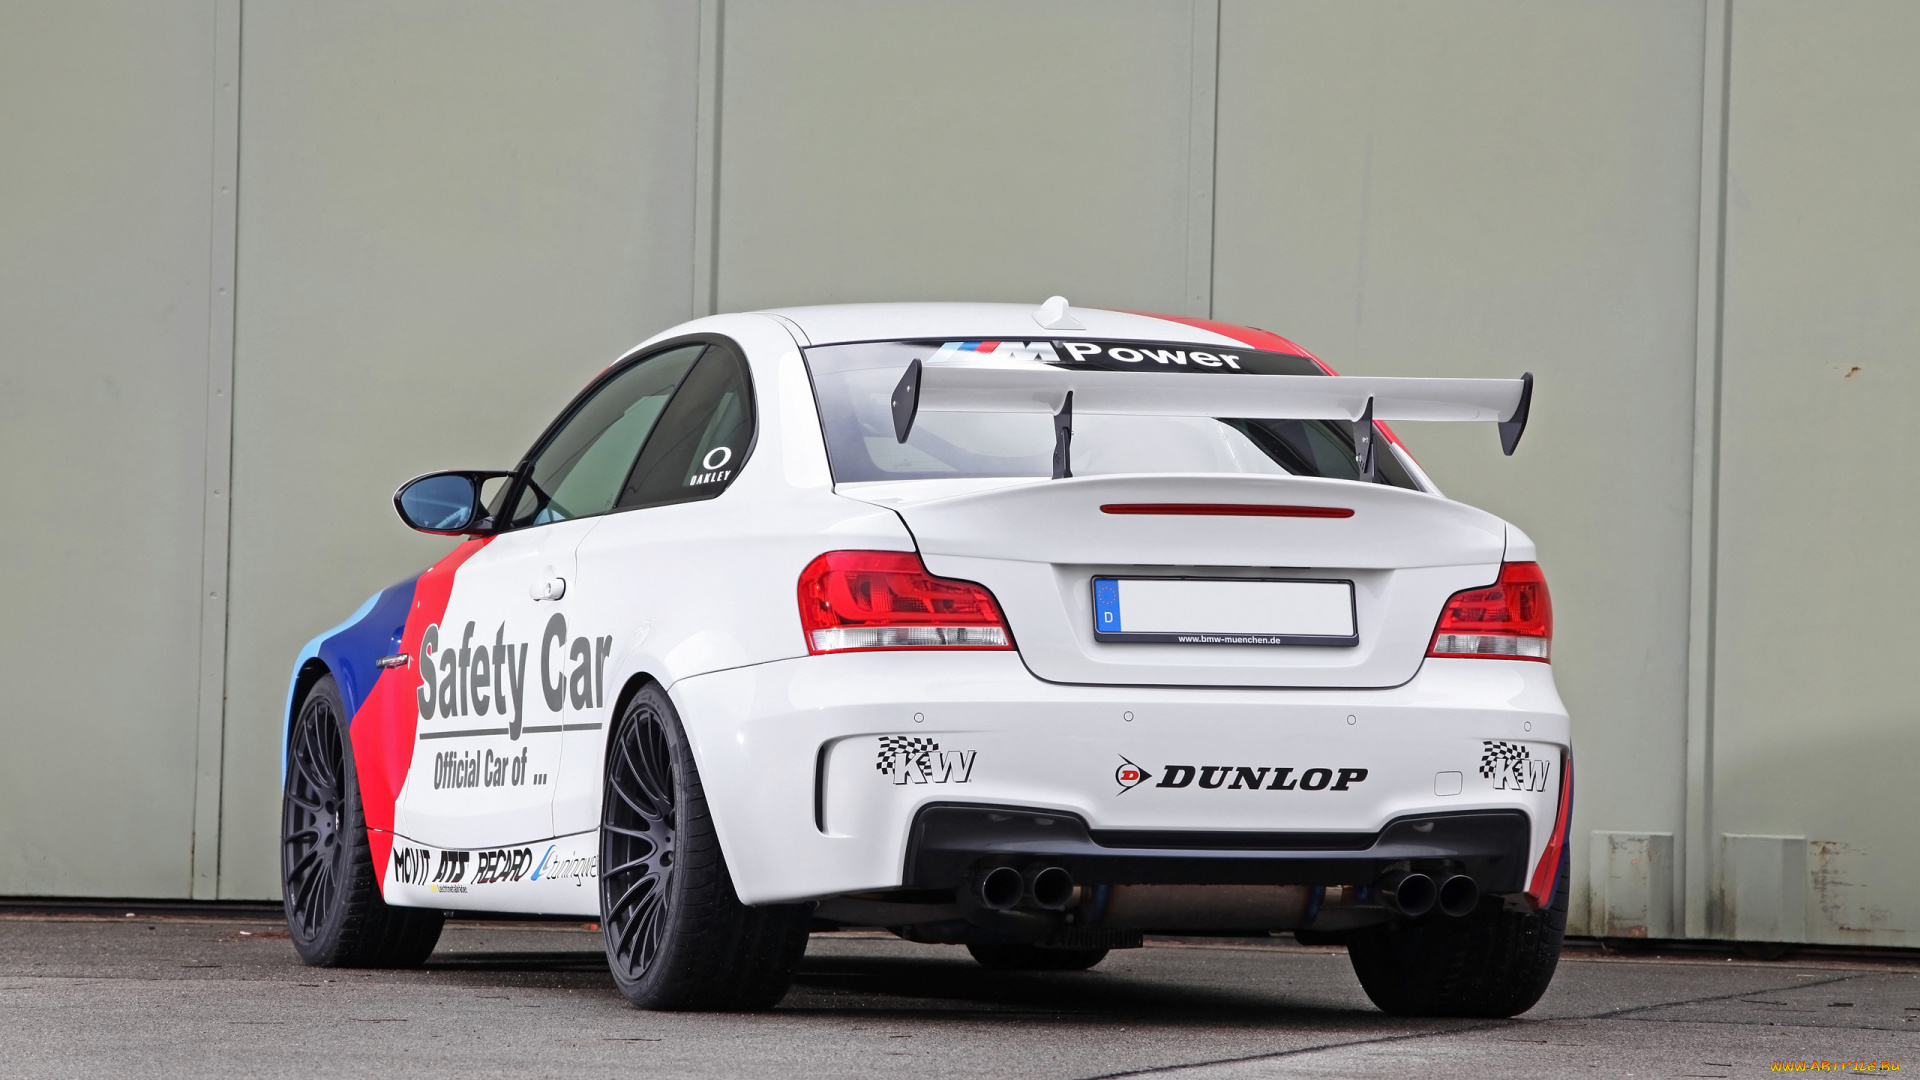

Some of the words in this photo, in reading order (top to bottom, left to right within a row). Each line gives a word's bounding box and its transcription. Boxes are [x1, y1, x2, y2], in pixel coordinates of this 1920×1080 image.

[1063, 342, 1241, 369] Power
[690, 470, 731, 485] OAKLEY
[1104, 611, 1114, 623] D
[1178, 634, 1281, 645] www.bmw-muenchen.de
[417, 620, 528, 741] Safety
[541, 612, 613, 712] Car
[434, 750, 481, 790] Official
[484, 748, 509, 787] Car
[511, 746, 528, 786] of
[893, 750, 977, 785] KW
[1155, 765, 1369, 791] DUNLOP
[1493, 758, 1550, 792] KW
[432, 850, 469, 883] ATS
[471, 847, 533, 885] RECARO
